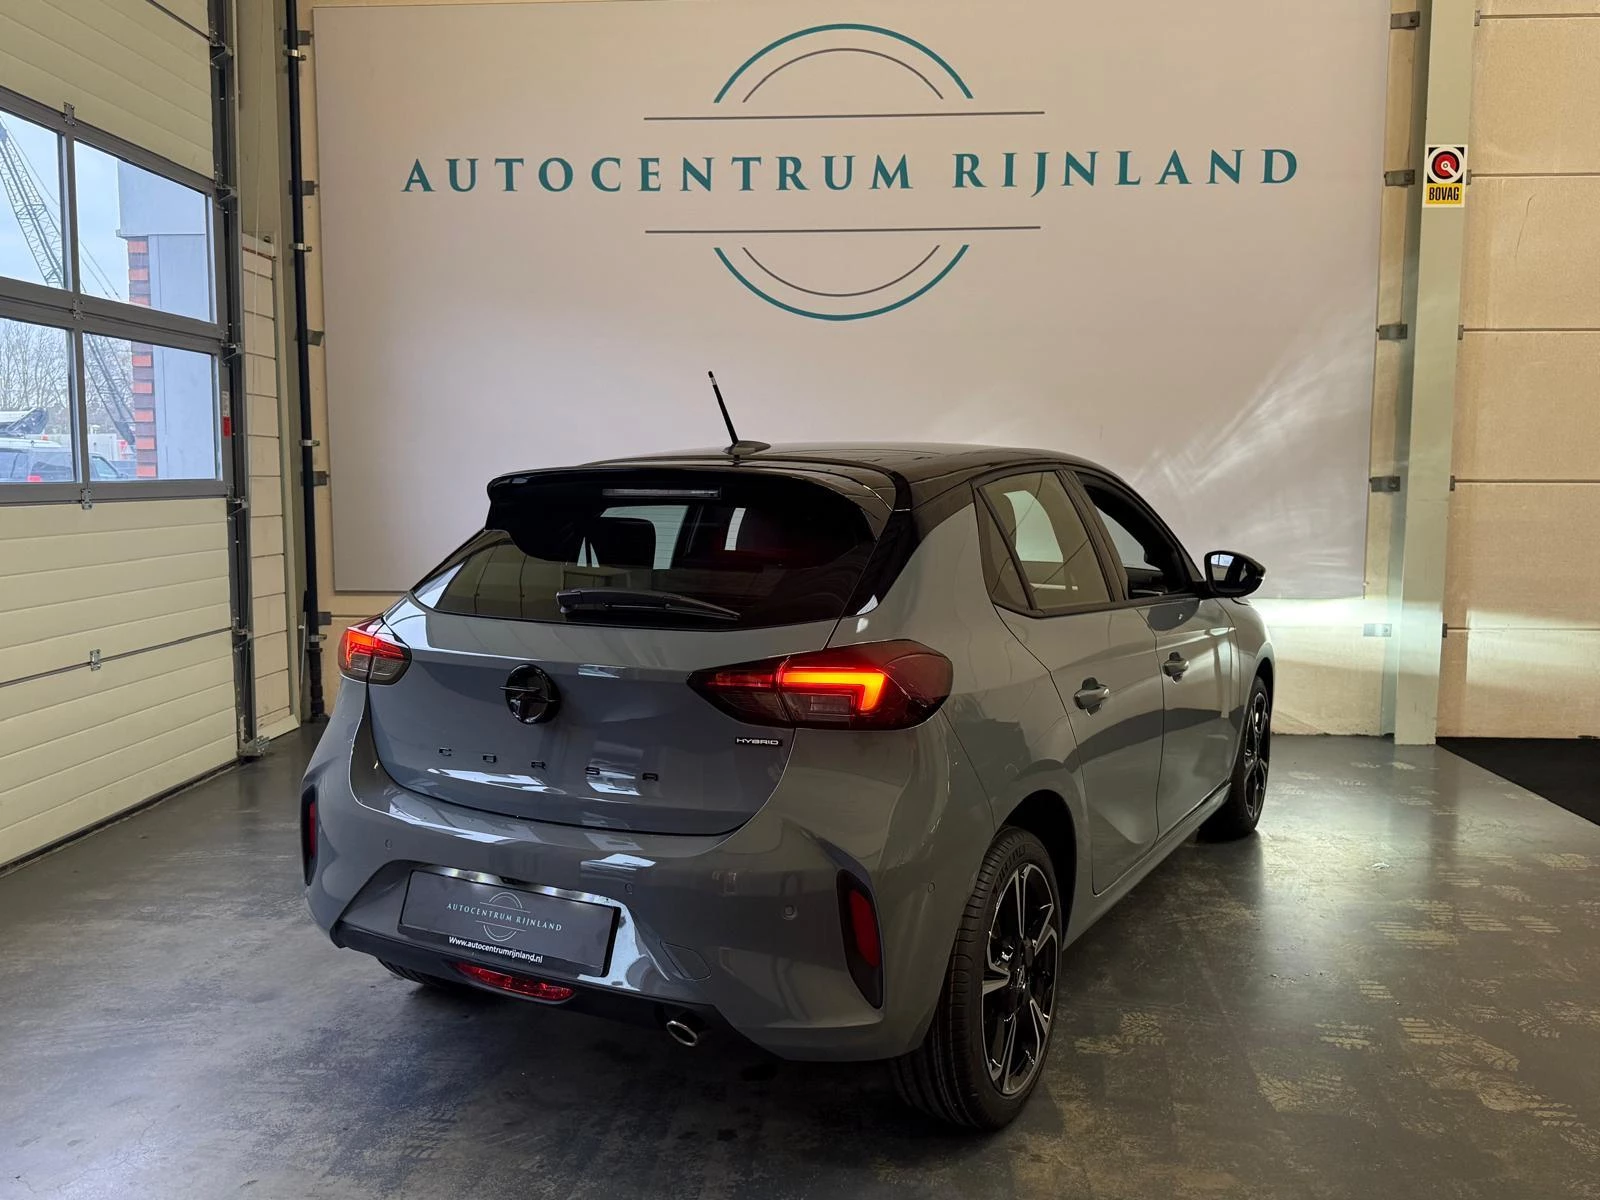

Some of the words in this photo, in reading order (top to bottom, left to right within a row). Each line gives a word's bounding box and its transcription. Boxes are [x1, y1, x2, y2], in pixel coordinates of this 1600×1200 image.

[400, 153, 913, 193] AUTOCENTRUM
[952, 148, 1298, 198] RIJNLAND
[1428, 186, 1460, 201] BOVAG
[736, 737, 779, 746] HYBRID
[446, 902, 513, 922] AUTOCENTRUM
[515, 915, 563, 932] RIJNLAND
